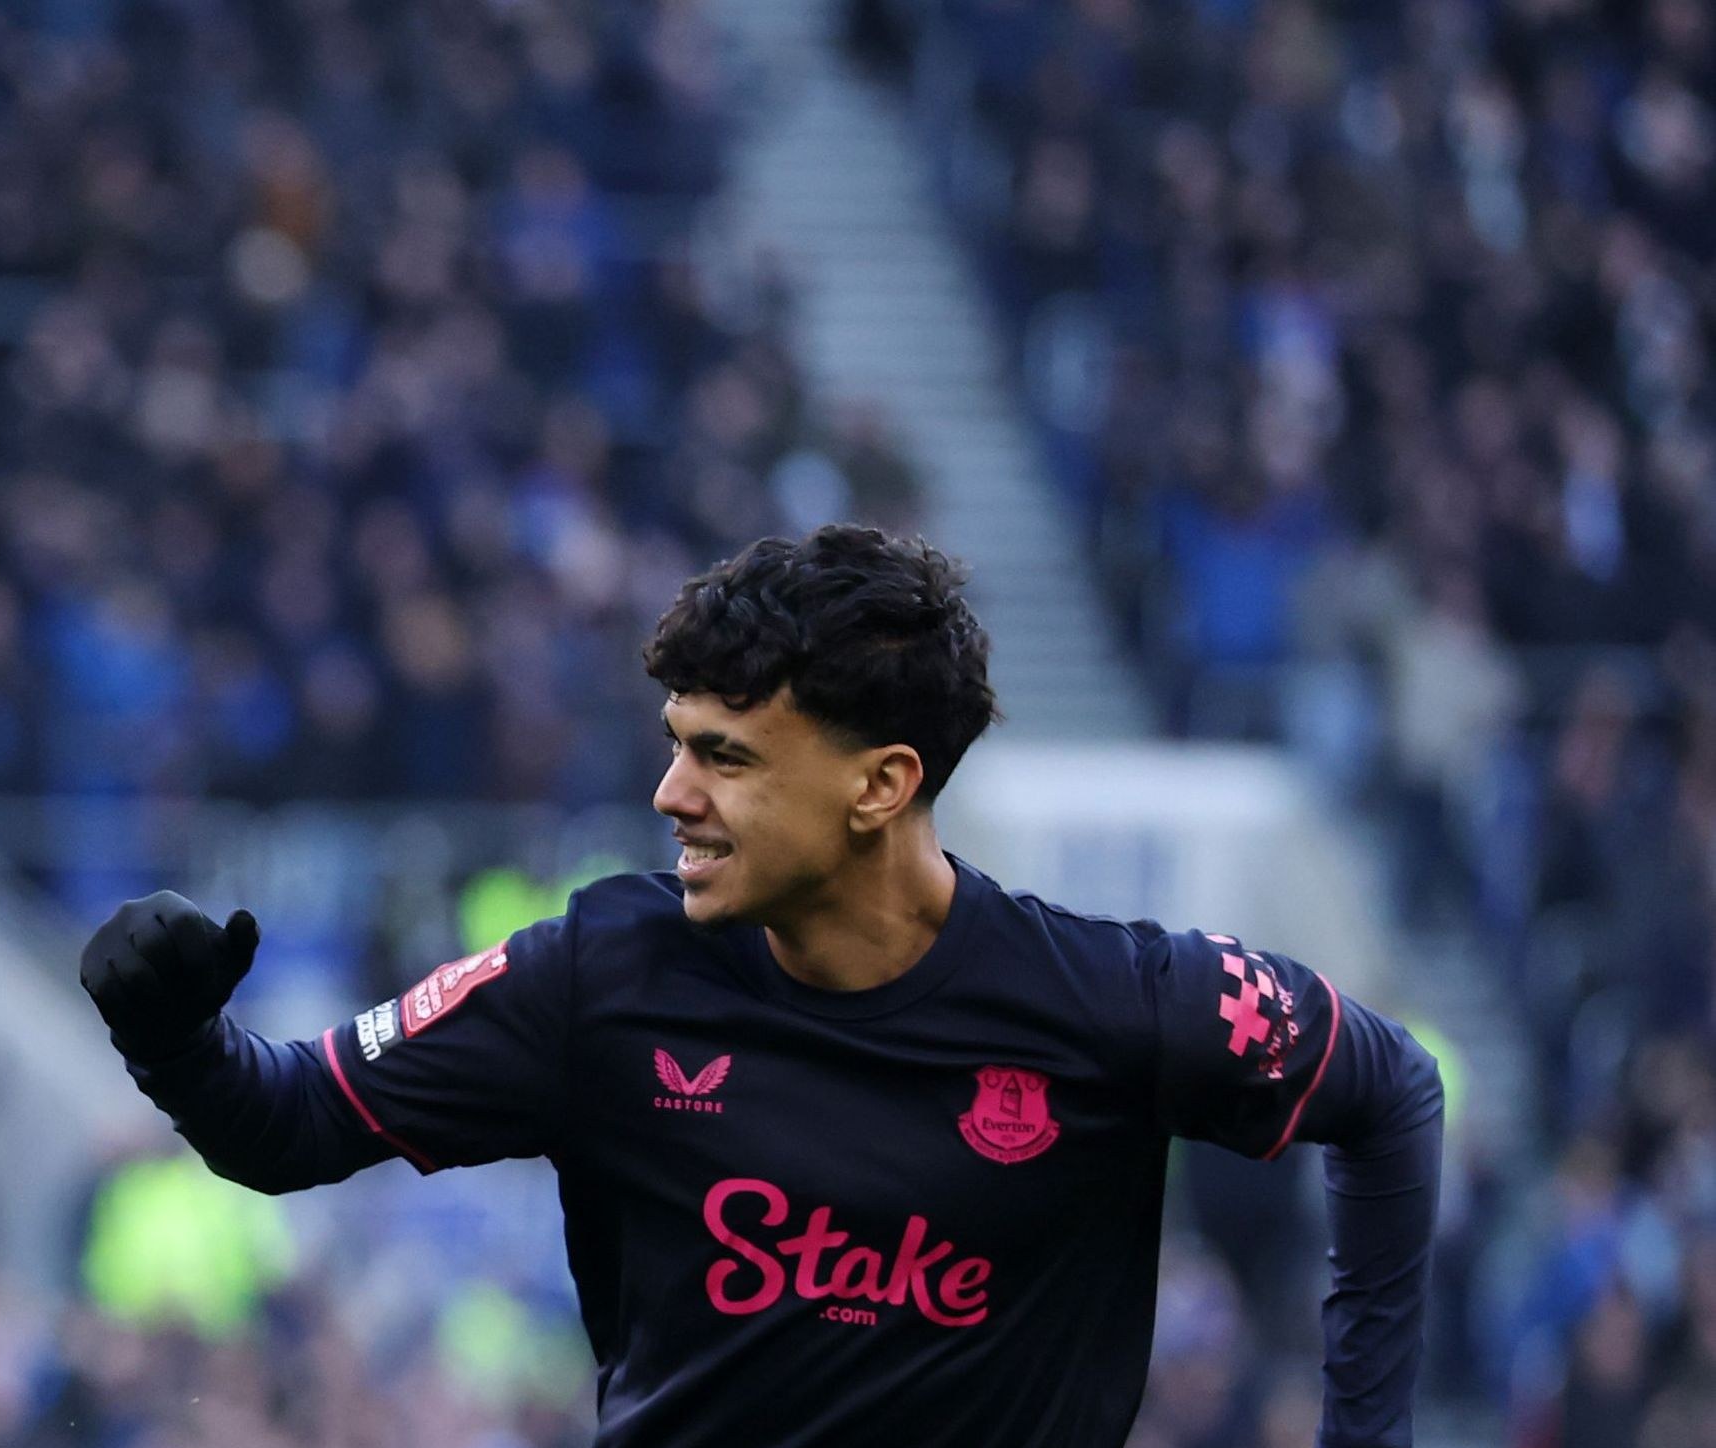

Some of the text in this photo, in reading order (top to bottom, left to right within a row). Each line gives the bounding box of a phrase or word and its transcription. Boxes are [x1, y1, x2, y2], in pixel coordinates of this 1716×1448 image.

[654, 1097, 723, 1113] CASTORE
[982, 1116, 1036, 1133] Everton
[703, 1177, 992, 1327] Stake
[819, 1305, 877, 1327] .com
